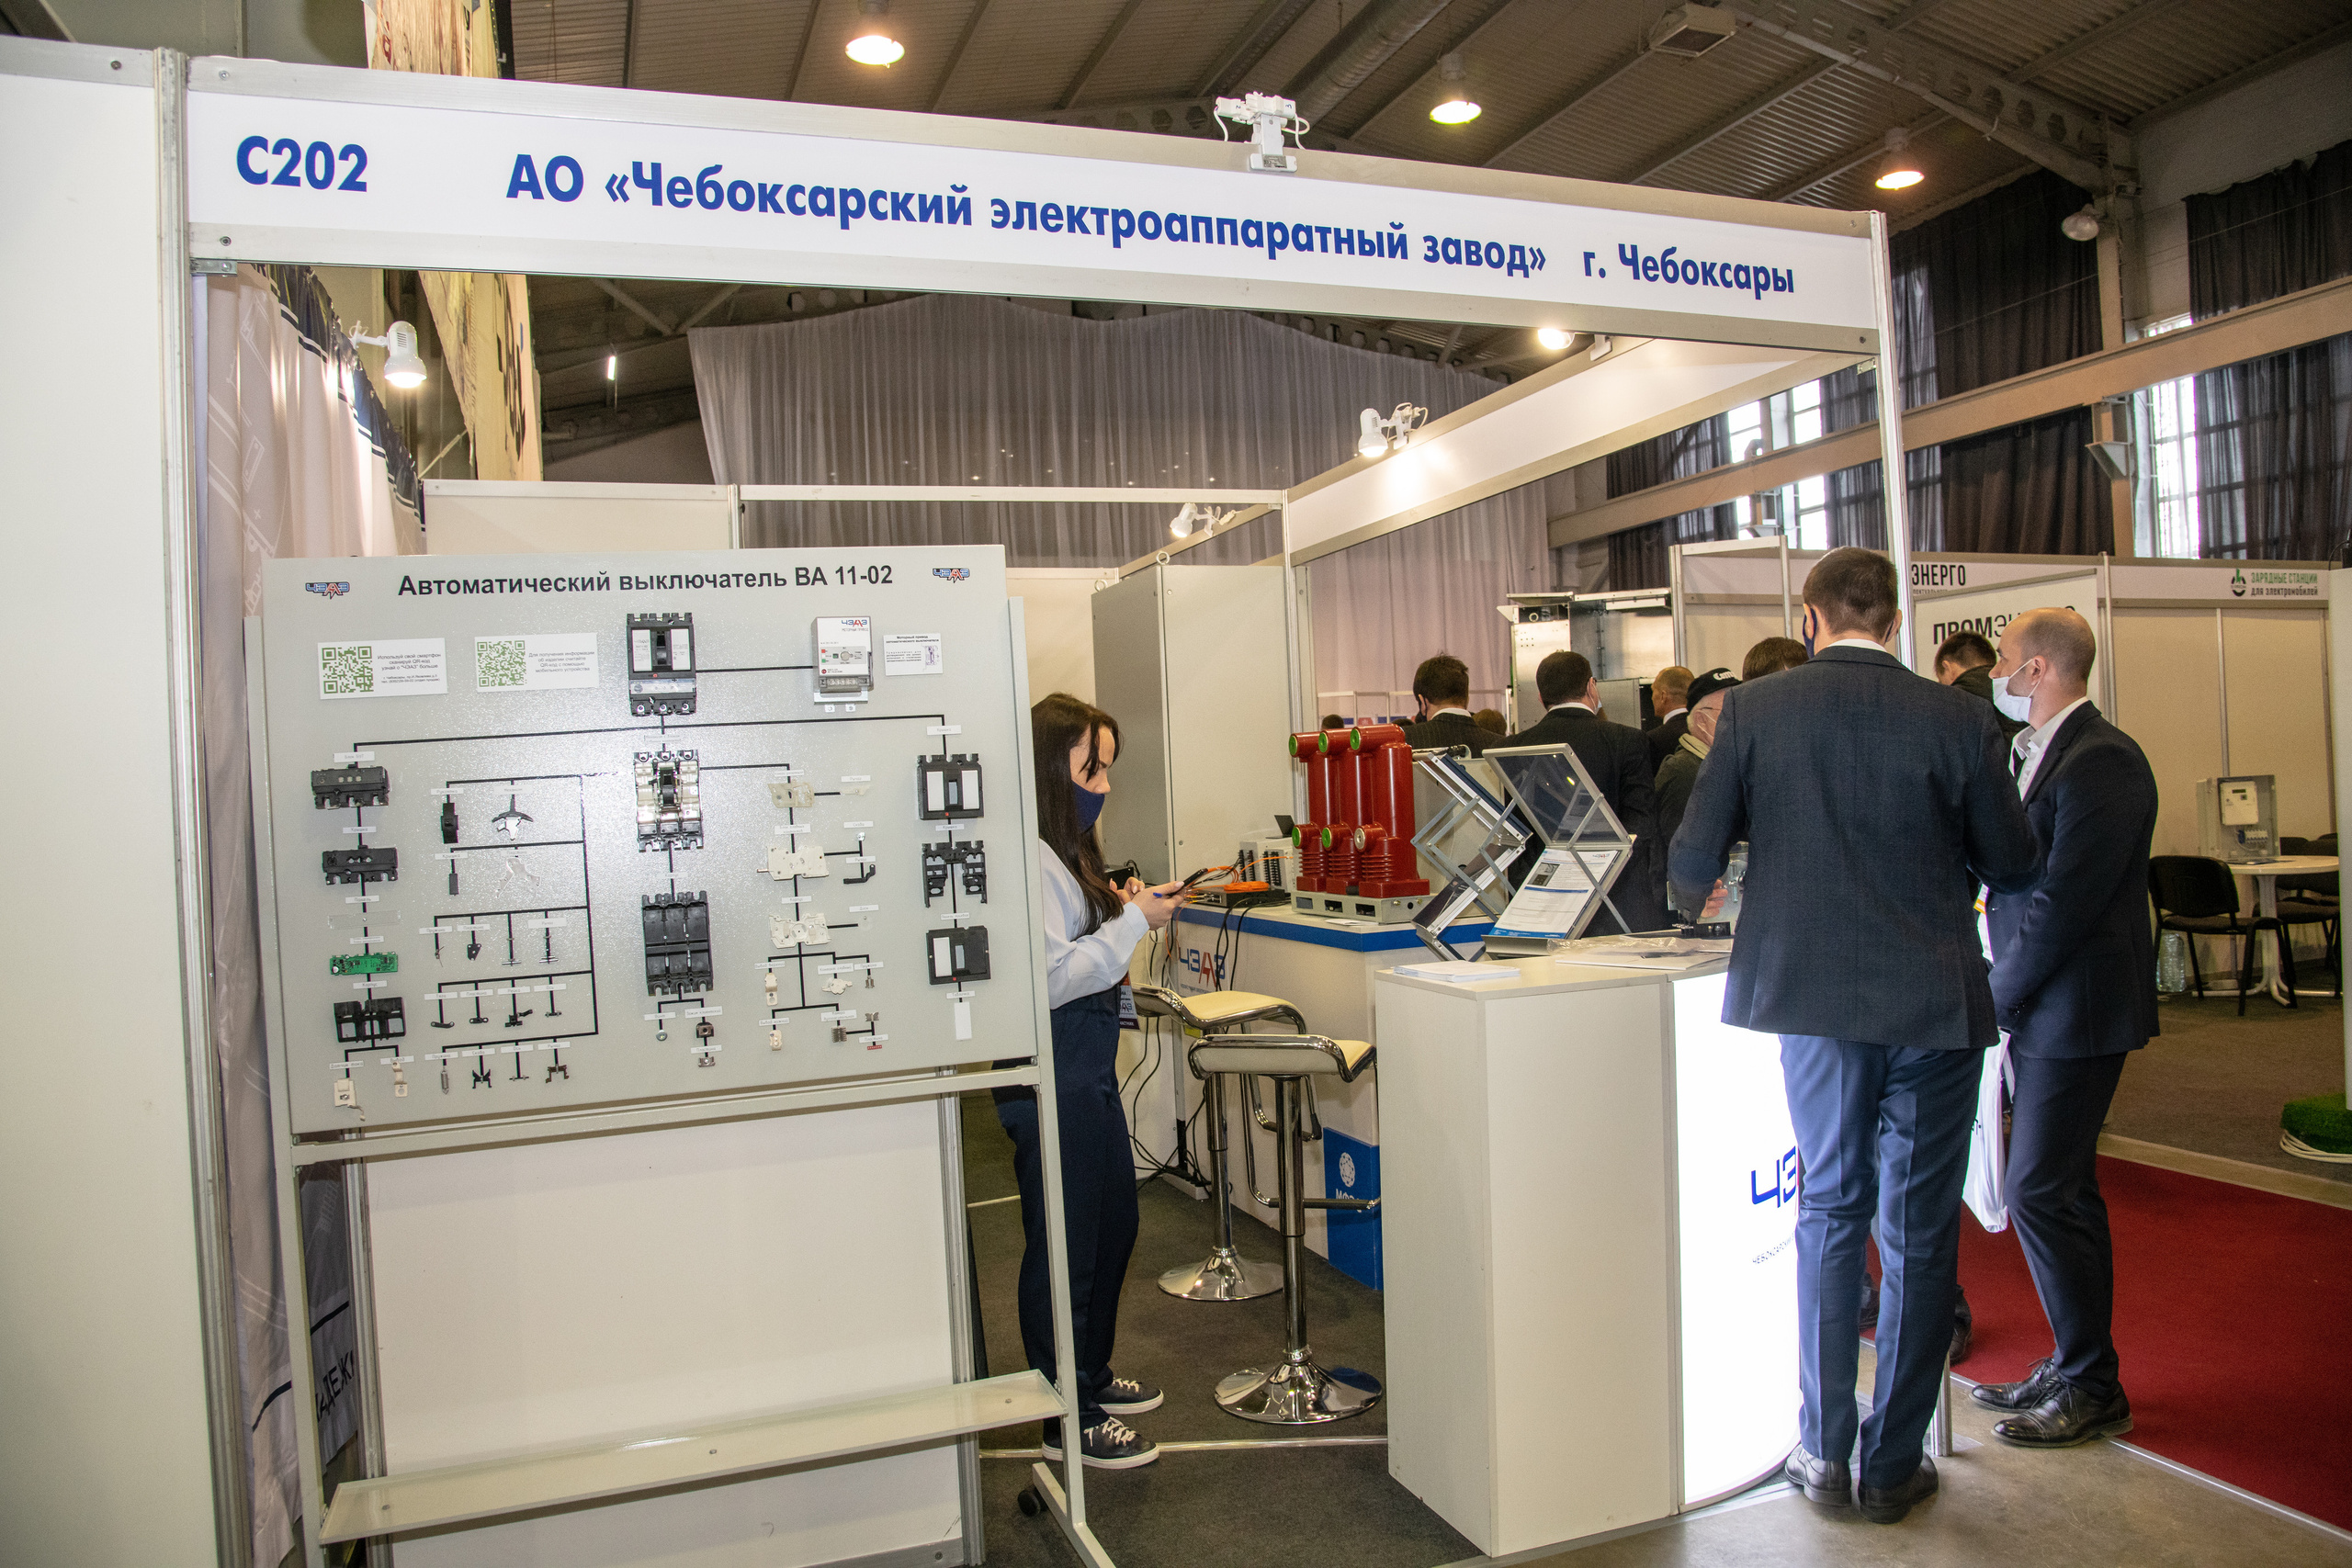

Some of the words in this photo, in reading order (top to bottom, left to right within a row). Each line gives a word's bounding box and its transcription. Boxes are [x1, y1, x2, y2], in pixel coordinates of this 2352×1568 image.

[506, 153, 584, 202] АО
[605, 161, 972, 230] «Чебоксарский
[990, 197, 1409, 260] электроаппаратный
[1422, 234, 1546, 278] завод»
[1583, 251, 1607, 278] г.
[1618, 243, 1795, 300] Чебоксары
[398, 571, 611, 596] Автоматический
[619, 571, 788, 591] выключатель
[795, 566, 828, 586] ВА
[835, 564, 893, 585] 11-02
[2251, 572, 2287, 584] ЗАРЯДНЫЕ
[2289, 572, 2317, 584] СТАНЦИИ
[2250, 587, 2264, 596] для
[2266, 585, 2318, 597] электромобилей
